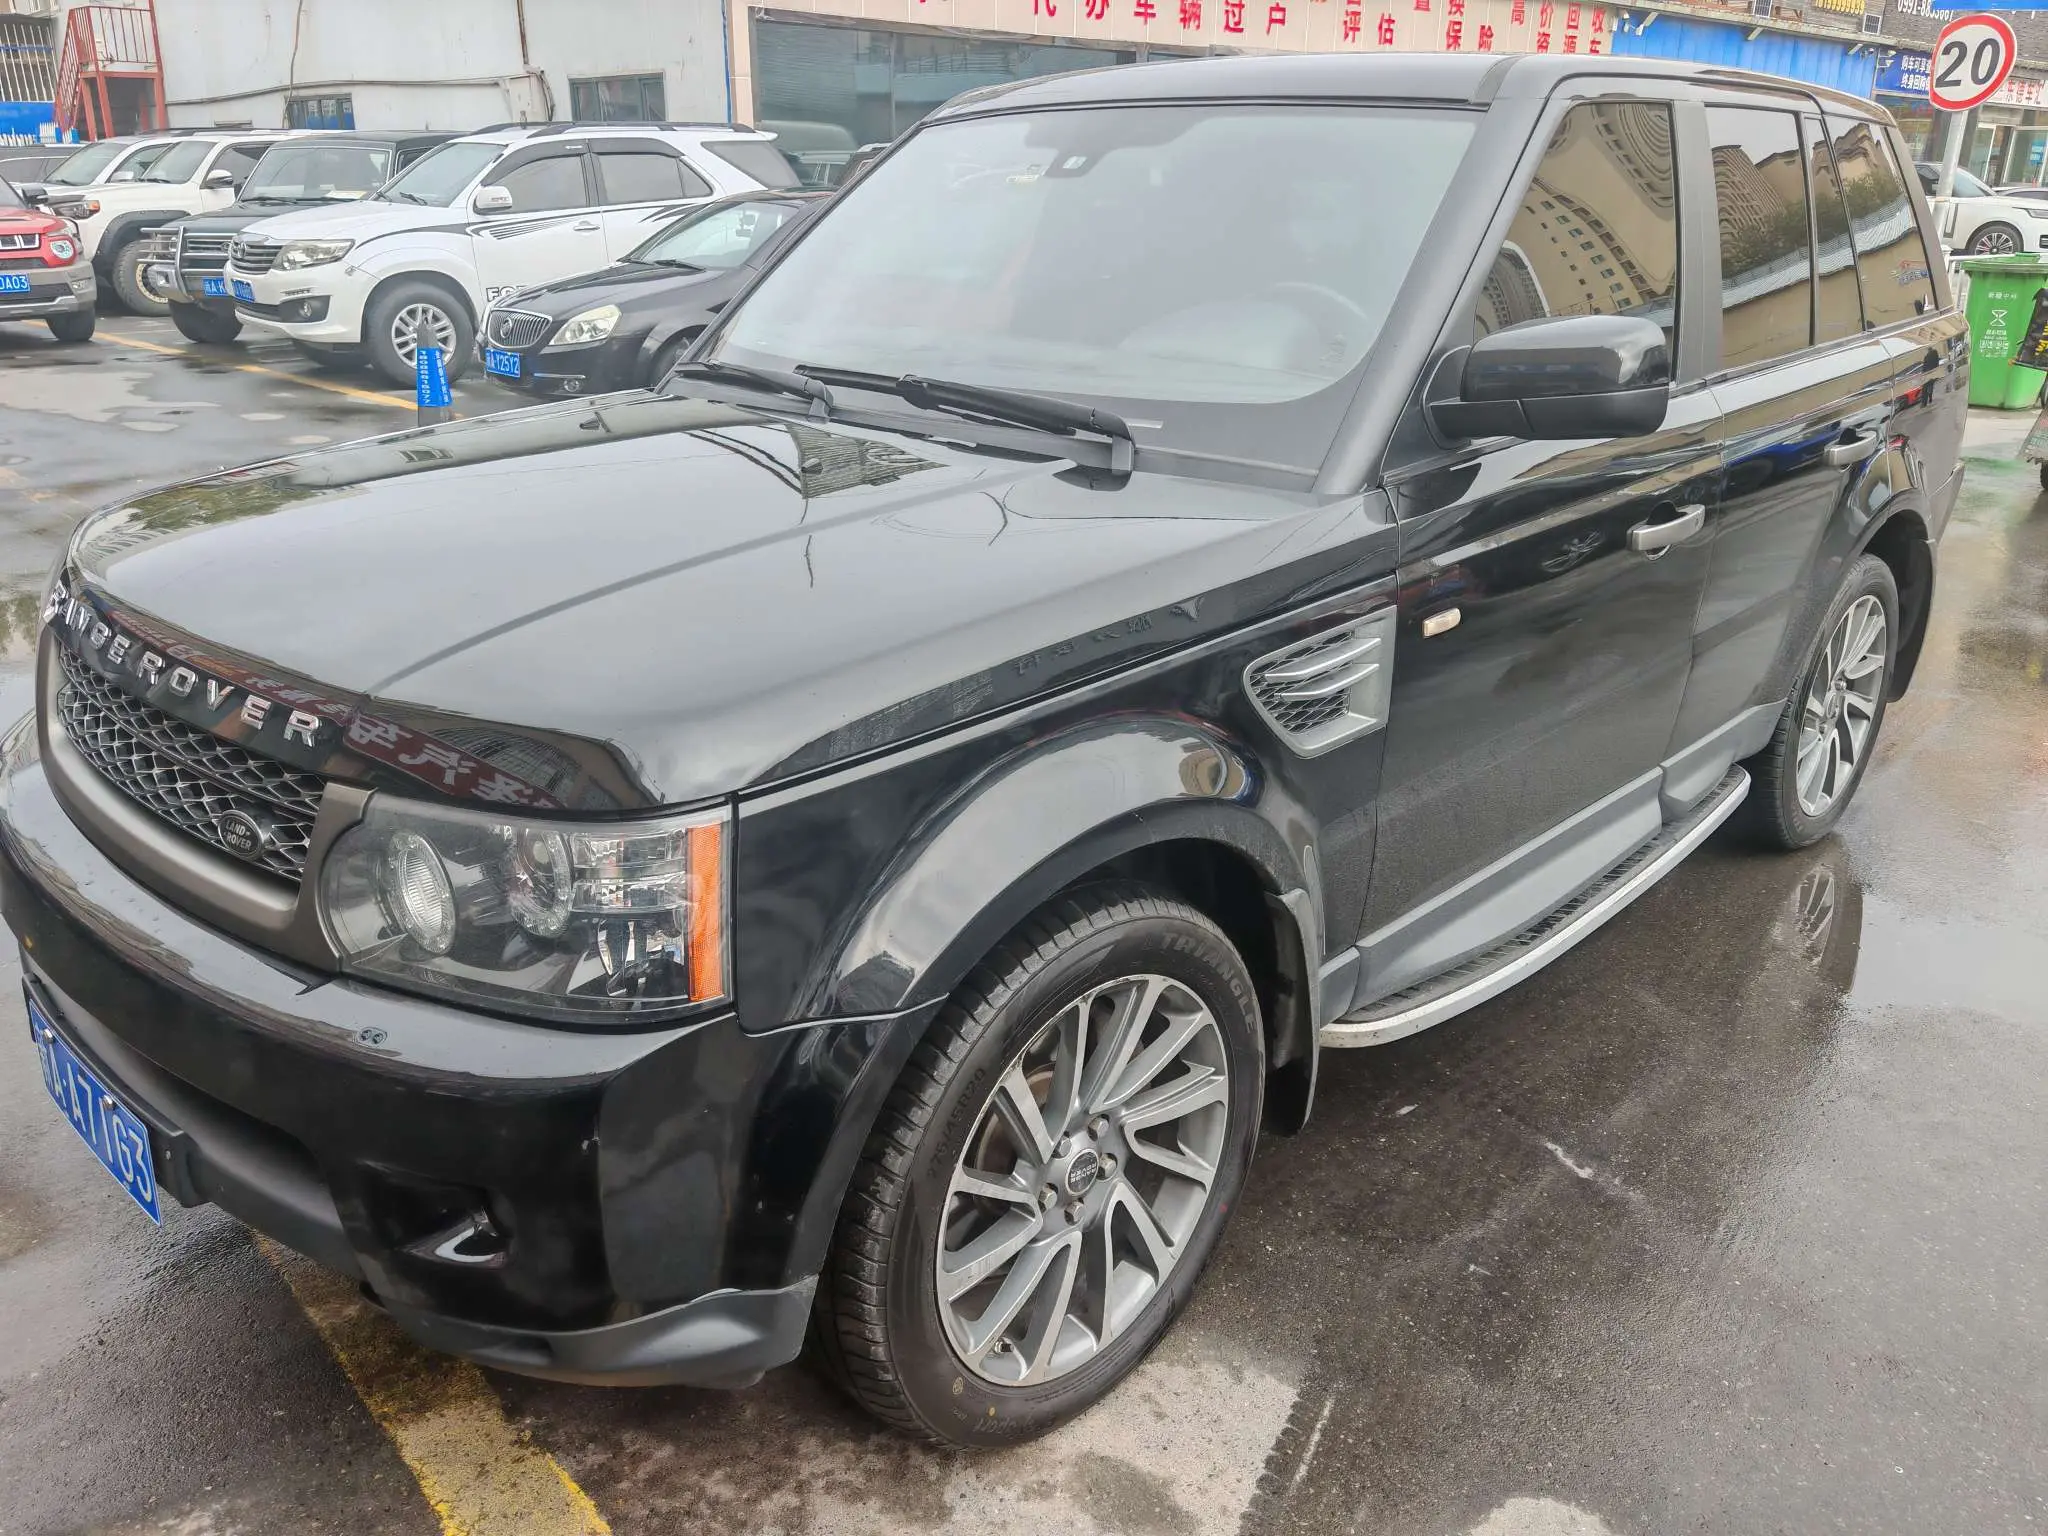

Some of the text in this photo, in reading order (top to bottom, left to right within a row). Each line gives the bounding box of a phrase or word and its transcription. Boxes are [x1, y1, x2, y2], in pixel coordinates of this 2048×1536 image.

[1343, 9, 1396, 46] 评估
[1446, 20, 1494, 52] 保险
[1934, 37, 2000, 88] 20
[43, 579, 132, 665] RANGE
[137, 650, 321, 748] ROVER
[225, 820, 246, 836] LAND
[226, 831, 252, 851] ROVER
[1162, 932, 1258, 1034] TRIANGLE
